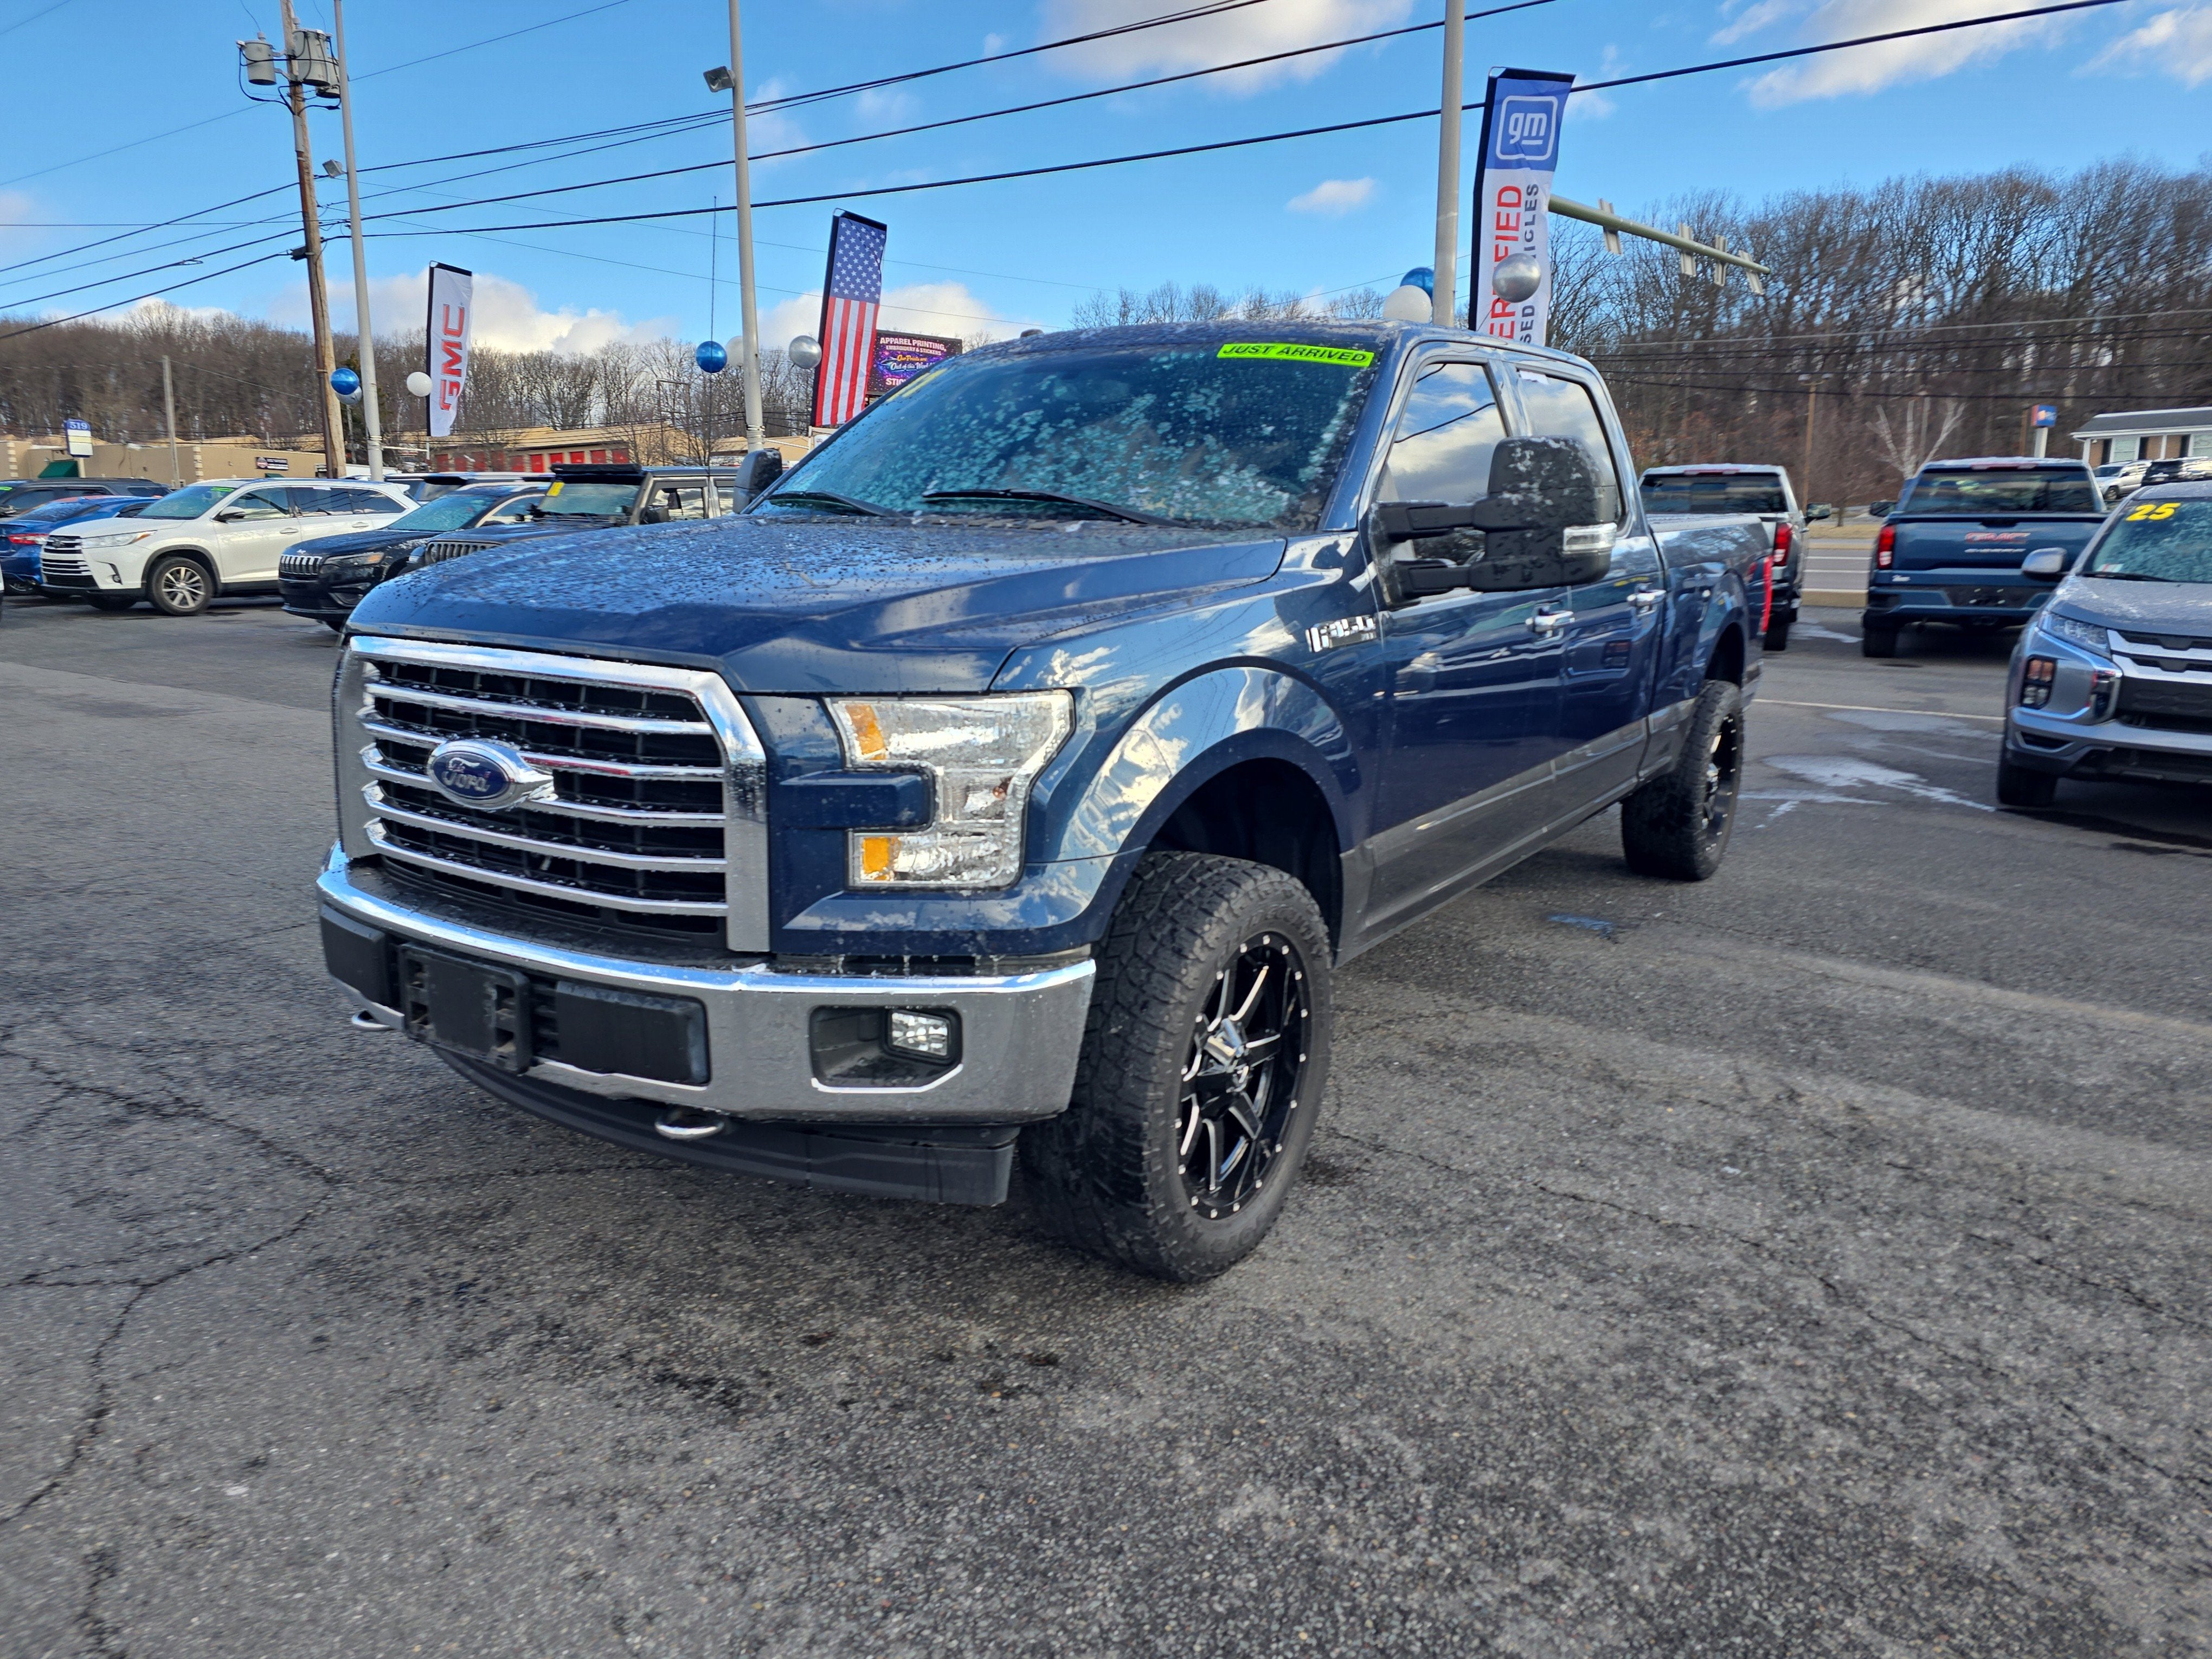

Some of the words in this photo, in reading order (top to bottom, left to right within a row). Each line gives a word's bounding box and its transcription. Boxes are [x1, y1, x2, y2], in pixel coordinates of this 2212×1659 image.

[1508, 112, 1548, 145] gm
[880, 337, 912, 346] APPAREL
[912, 339, 947, 352] PRINTING,
[1223, 344, 1276, 355] JUST
[1277, 346, 1367, 363] ARRIVED
[440, 304, 465, 411] GMC
[69, 421, 88, 429] 519
[2125, 502, 2181, 522] 25
[441, 757, 491, 792] Ford
